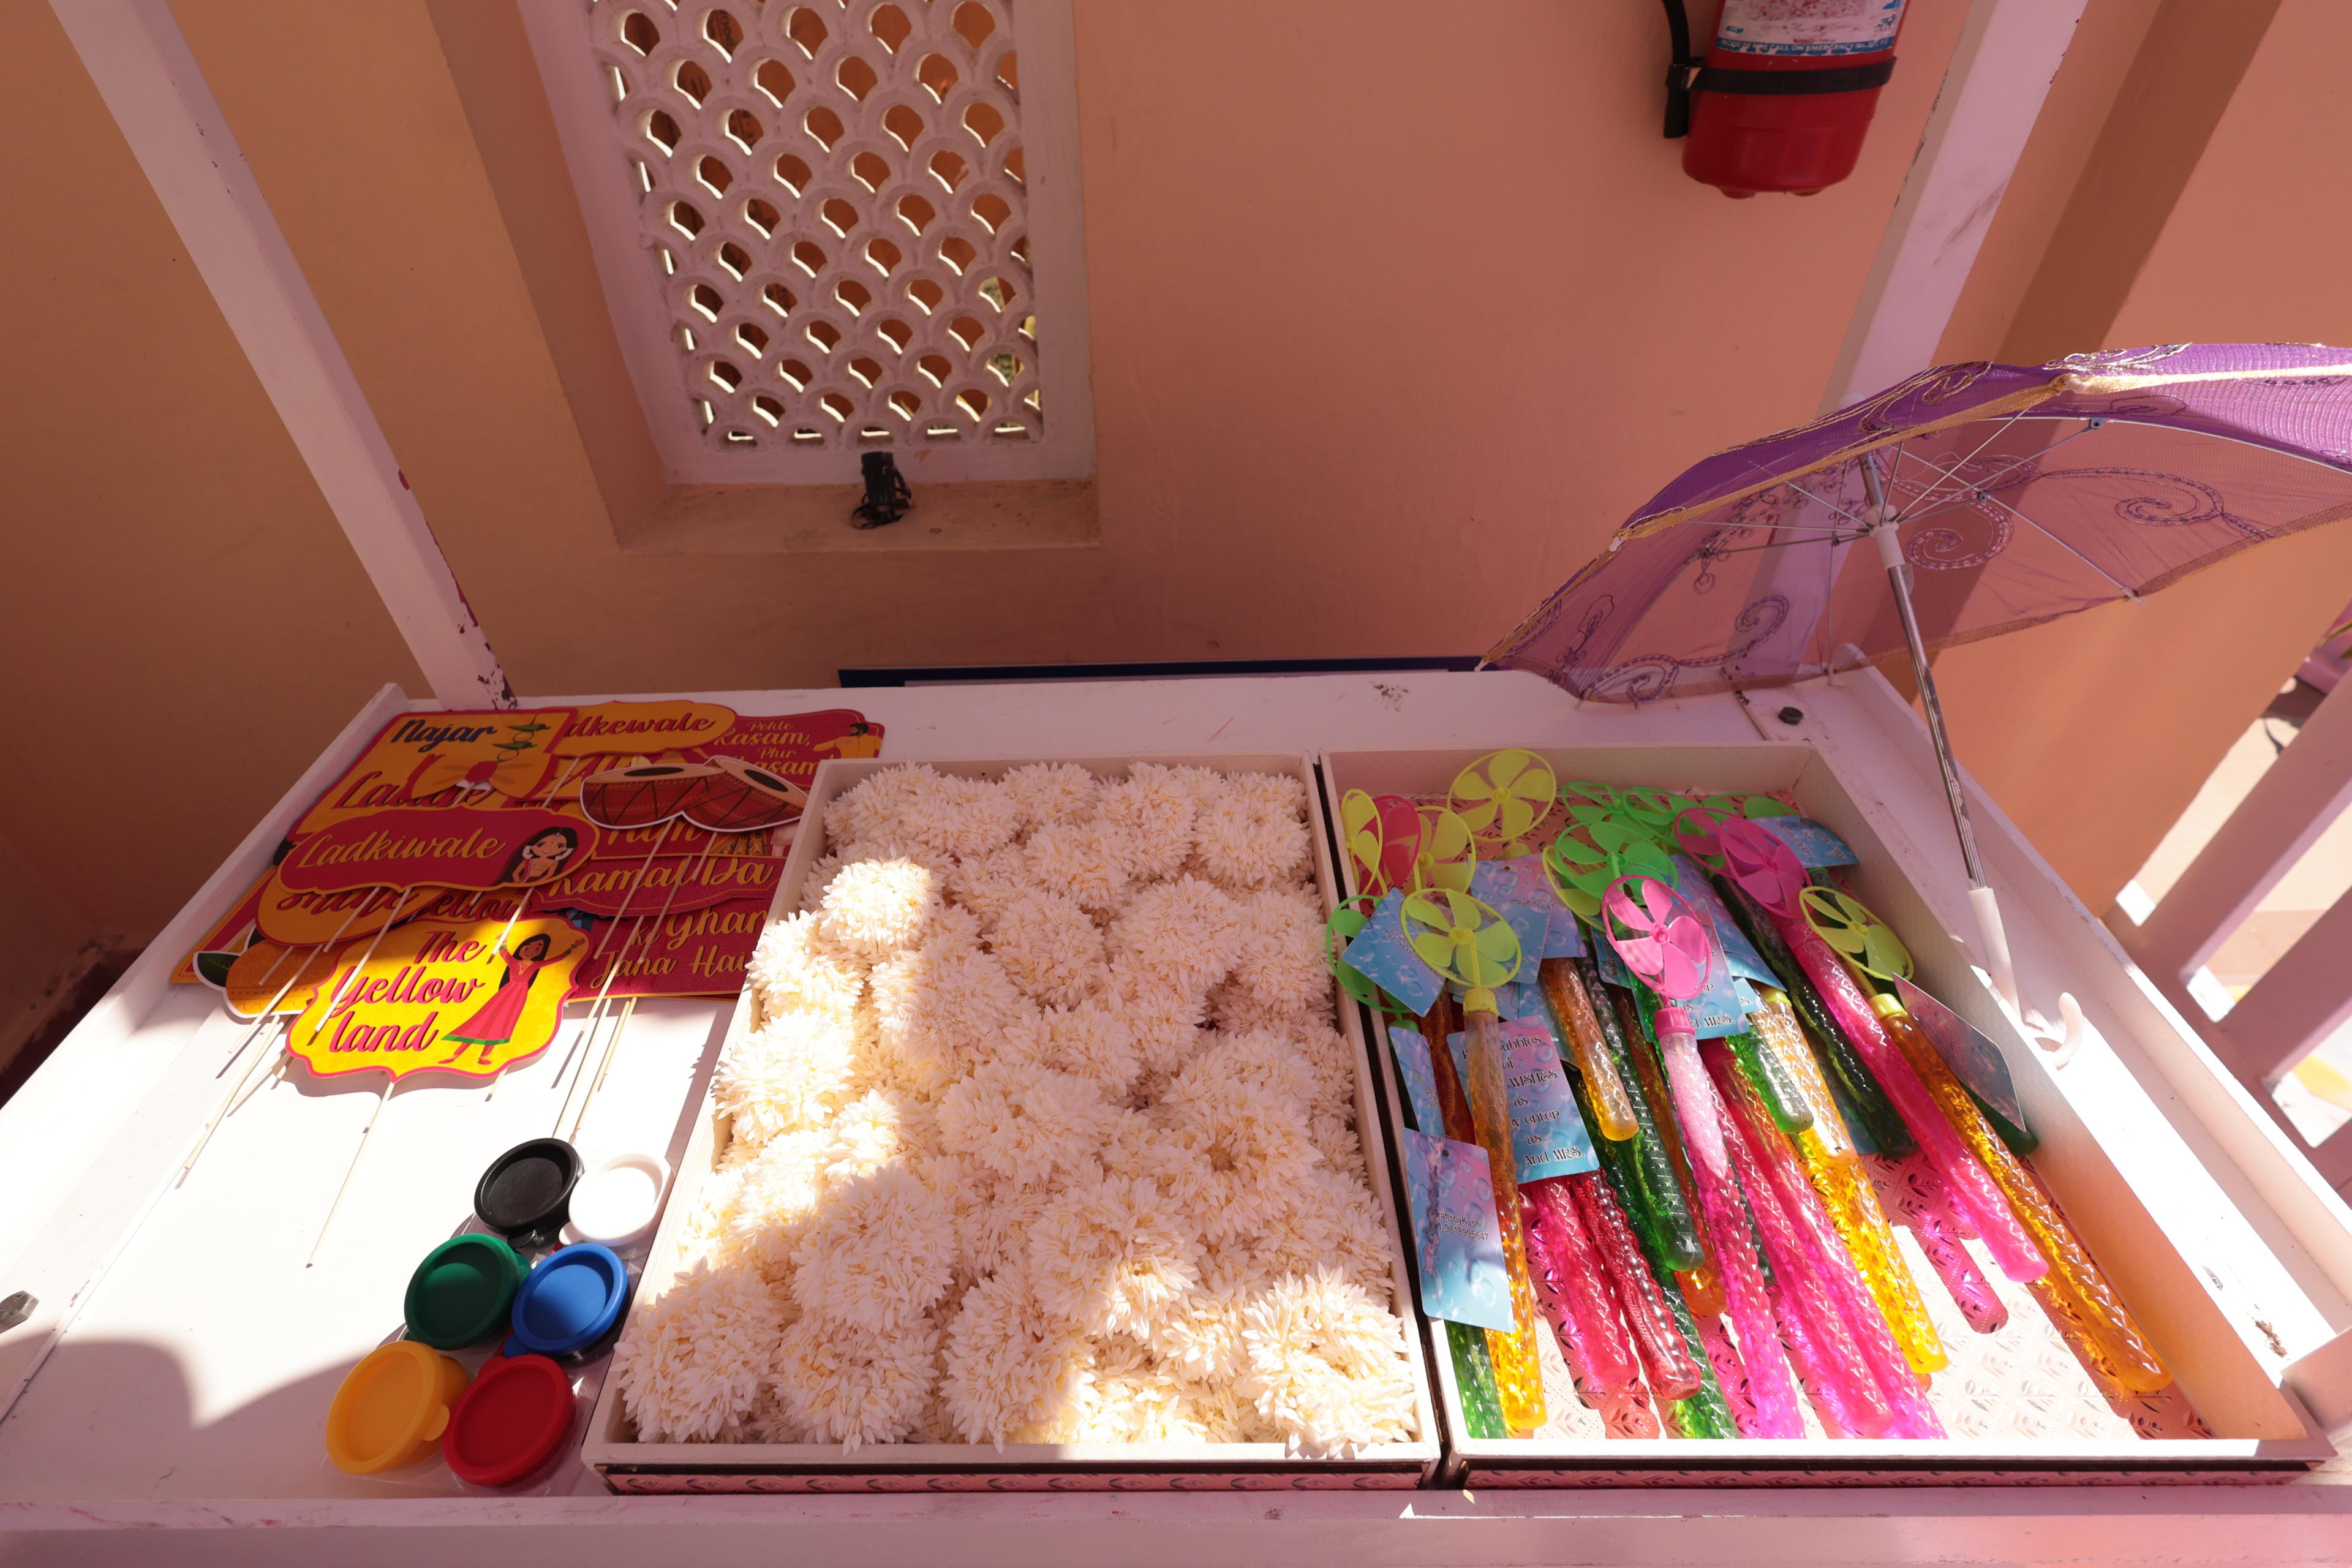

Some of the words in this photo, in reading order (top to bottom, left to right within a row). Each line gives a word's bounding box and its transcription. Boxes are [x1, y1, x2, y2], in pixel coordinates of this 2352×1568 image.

[564, 712, 716, 738] dkewale
[747, 720, 796, 732] Pehle
[390, 719, 498, 753] Najar
[756, 747, 797, 760] Phir
[295, 827, 508, 869] Ladkiwale
[413, 930, 488, 965] The
[590, 949, 679, 990] Jana
[329, 965, 486, 1019] Yellow
[1704, 1014, 1735, 1027] MRS.
[1500, 1036, 1542, 1052] ubbles
[1502, 1057, 1514, 1071] of
[1509, 1069, 1558, 1088] WISHES
[1513, 1096, 1529, 1107] as
[1525, 1109, 1561, 1125] enter
[1526, 1133, 1543, 1145] as
[1523, 1150, 1550, 1166] And
[1553, 1145, 1585, 1162] MRS.
[1430, 1221, 1489, 1242] 91-9818995647
